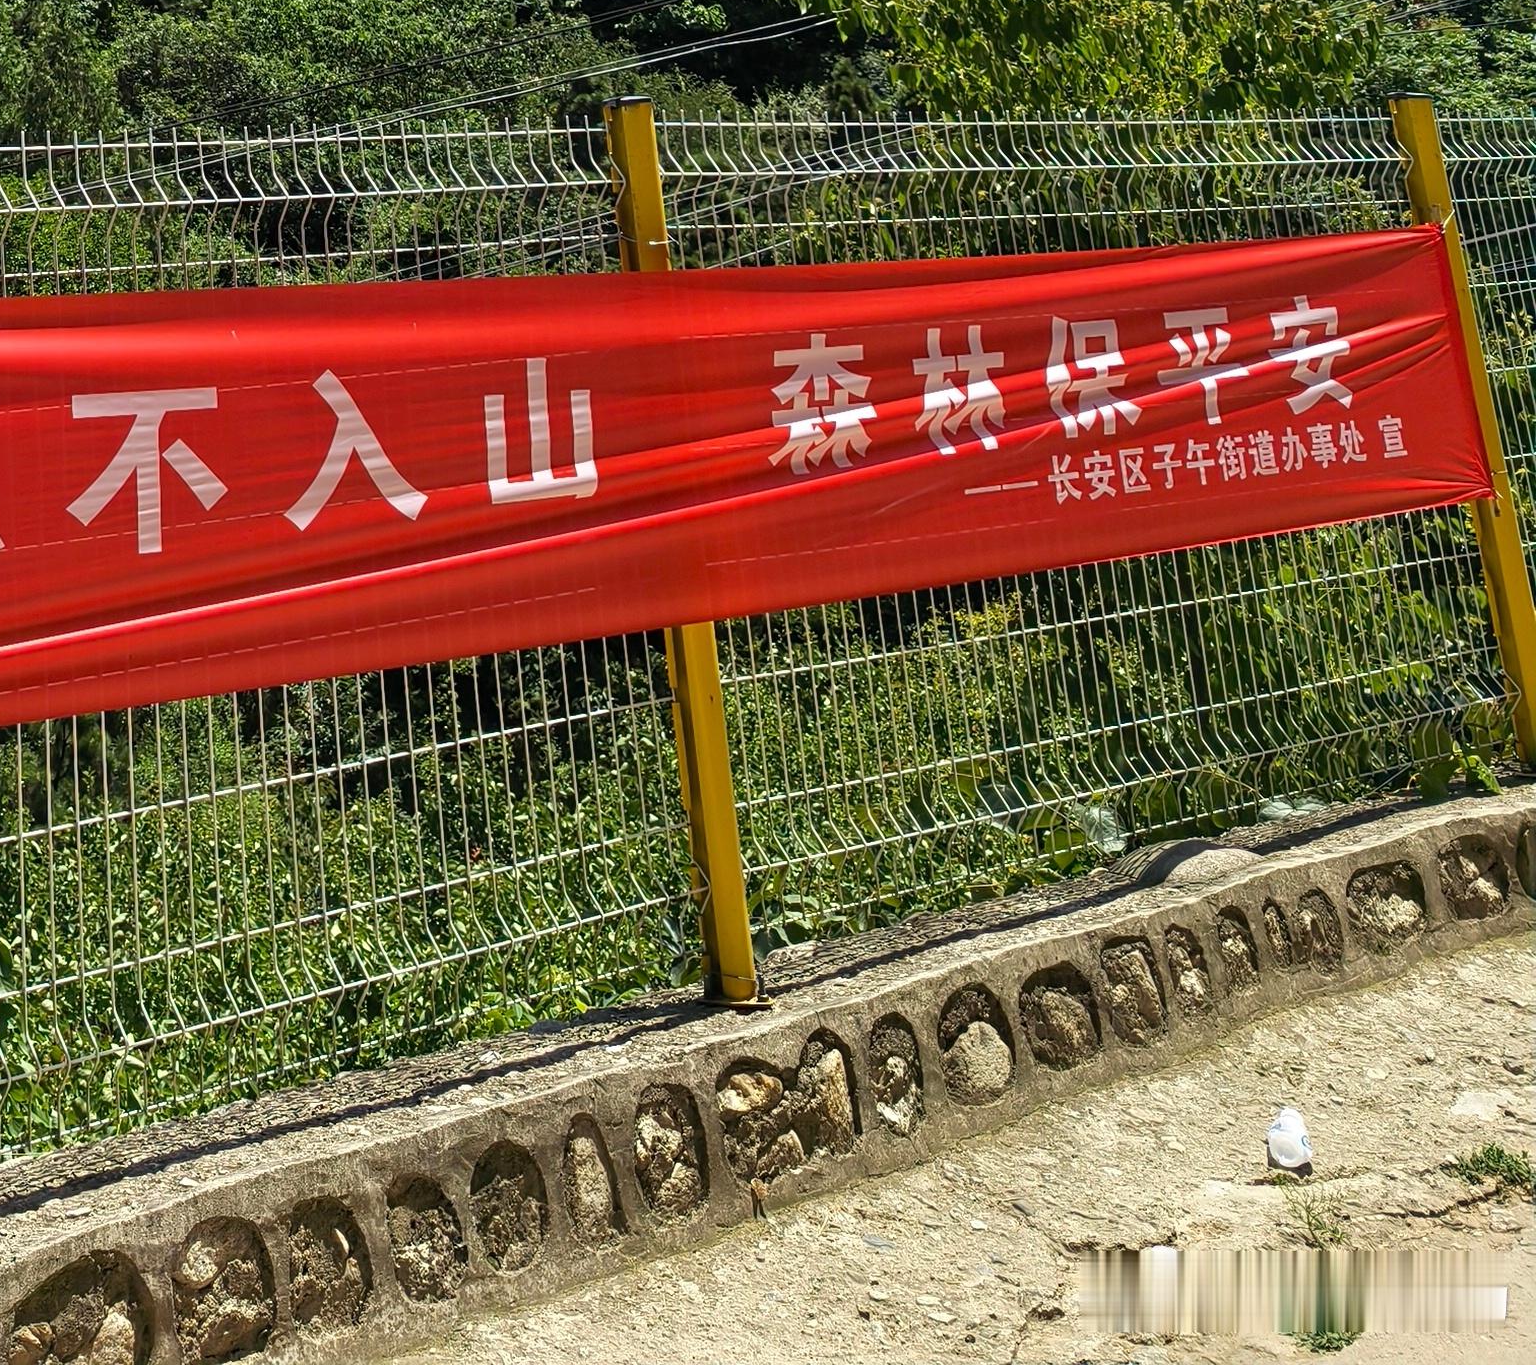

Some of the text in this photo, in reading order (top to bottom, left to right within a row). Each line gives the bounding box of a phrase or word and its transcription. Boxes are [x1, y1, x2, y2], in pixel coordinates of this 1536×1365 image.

[768, 296, 1353, 475] 森林保平安
